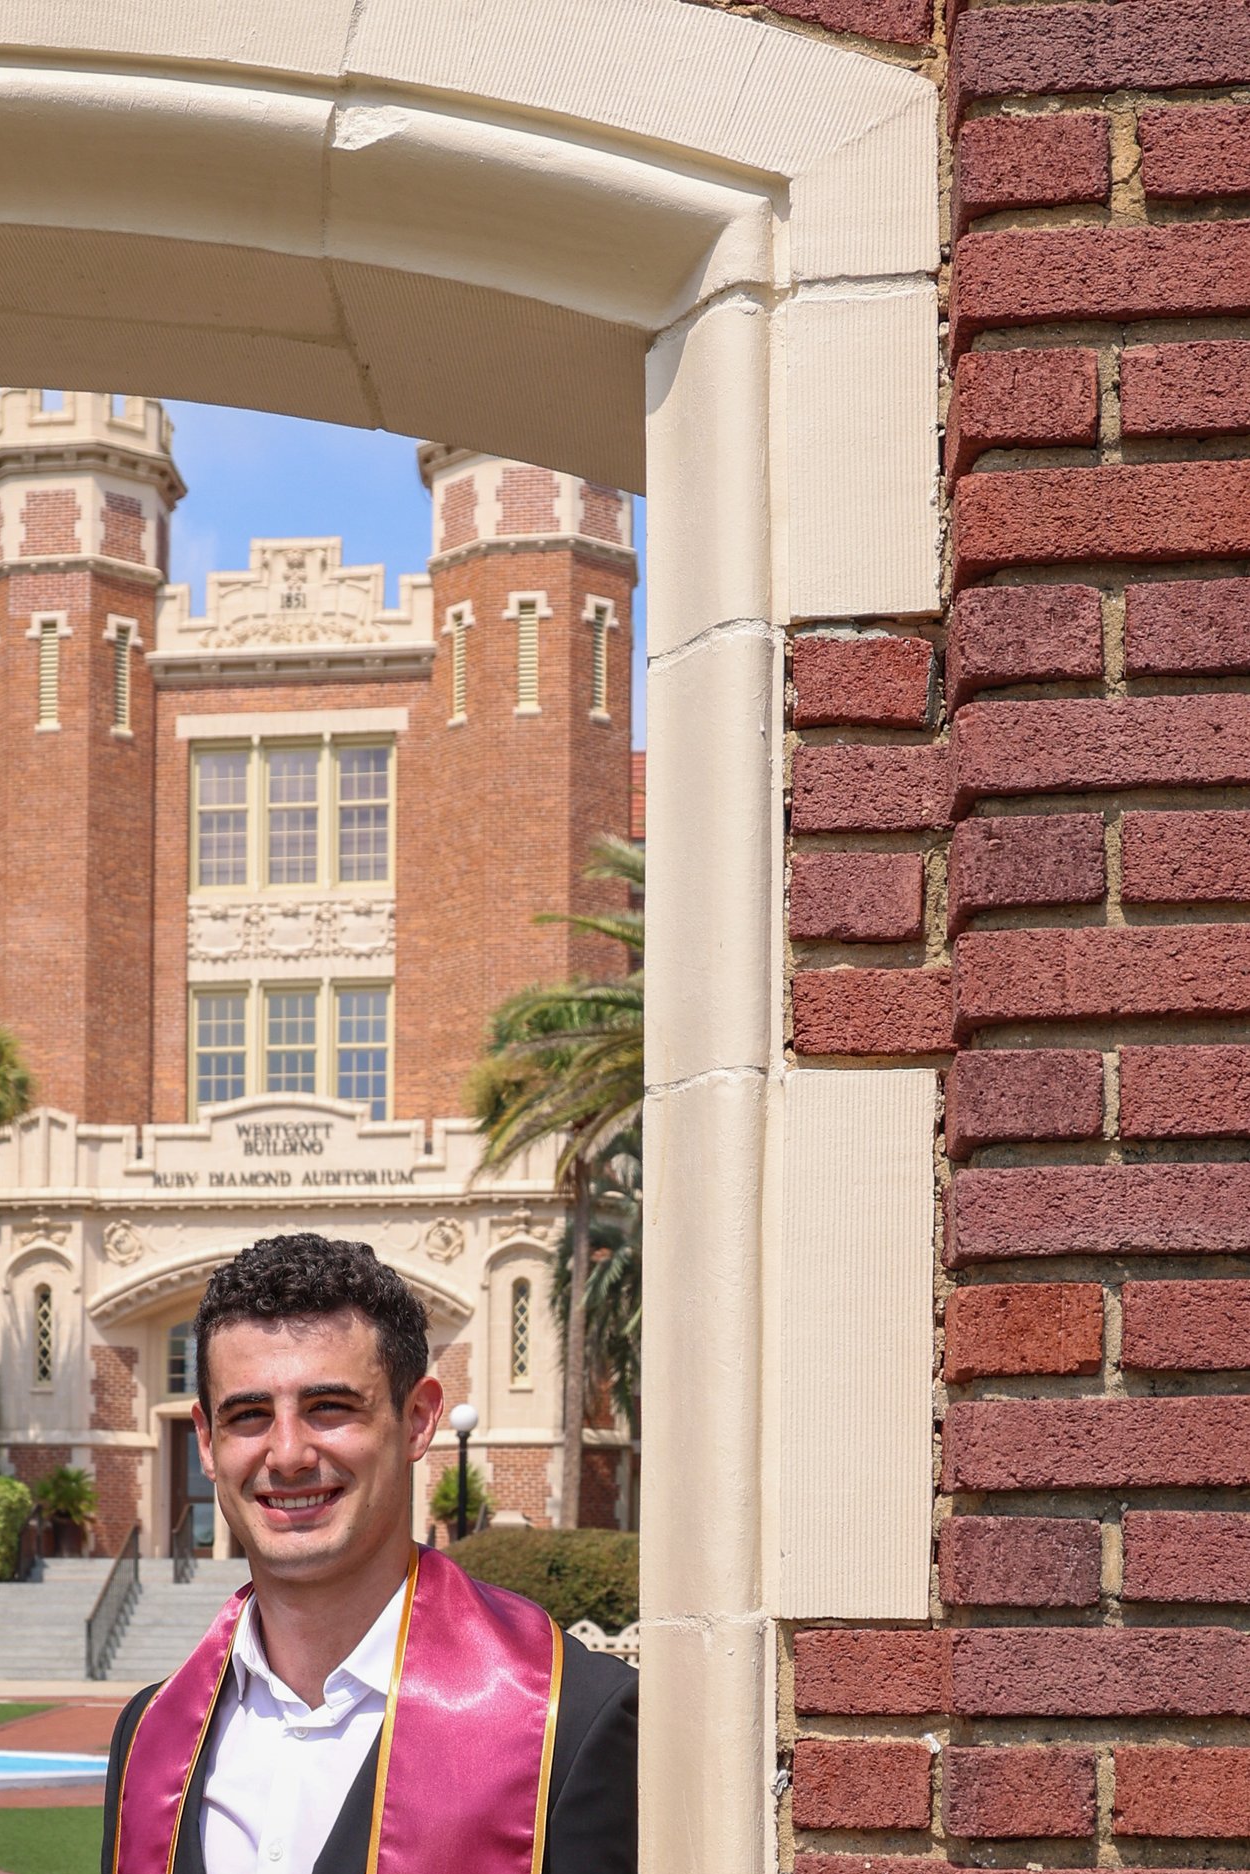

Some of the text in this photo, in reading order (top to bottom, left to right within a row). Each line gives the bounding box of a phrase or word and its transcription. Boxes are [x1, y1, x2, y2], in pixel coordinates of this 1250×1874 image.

[280, 592, 307, 609] 1851
[236, 1121, 334, 1140] WESTCOTT
[243, 1140, 324, 1157] BUILDING
[153, 1168, 415, 1188] RUBY DIAMOND AUDITORIUM
